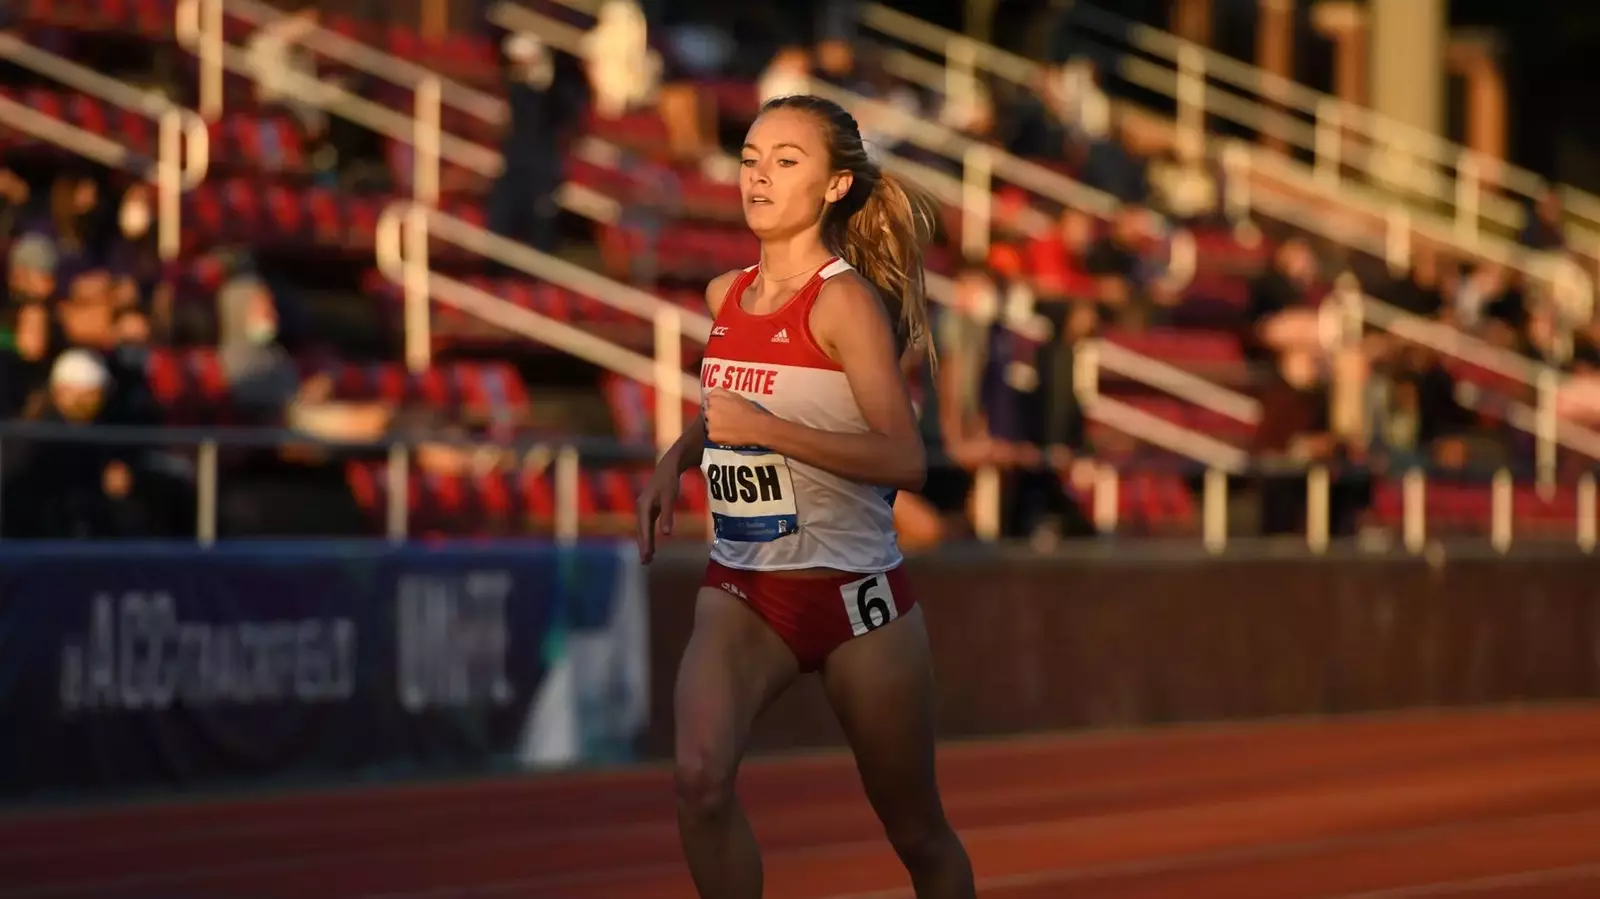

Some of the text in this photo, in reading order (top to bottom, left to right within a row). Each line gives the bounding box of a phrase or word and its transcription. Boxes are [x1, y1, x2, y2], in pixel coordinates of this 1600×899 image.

[702, 363, 778, 395] NC STATE
[707, 464, 783, 503] BUSH
[857, 577, 890, 631] 6
